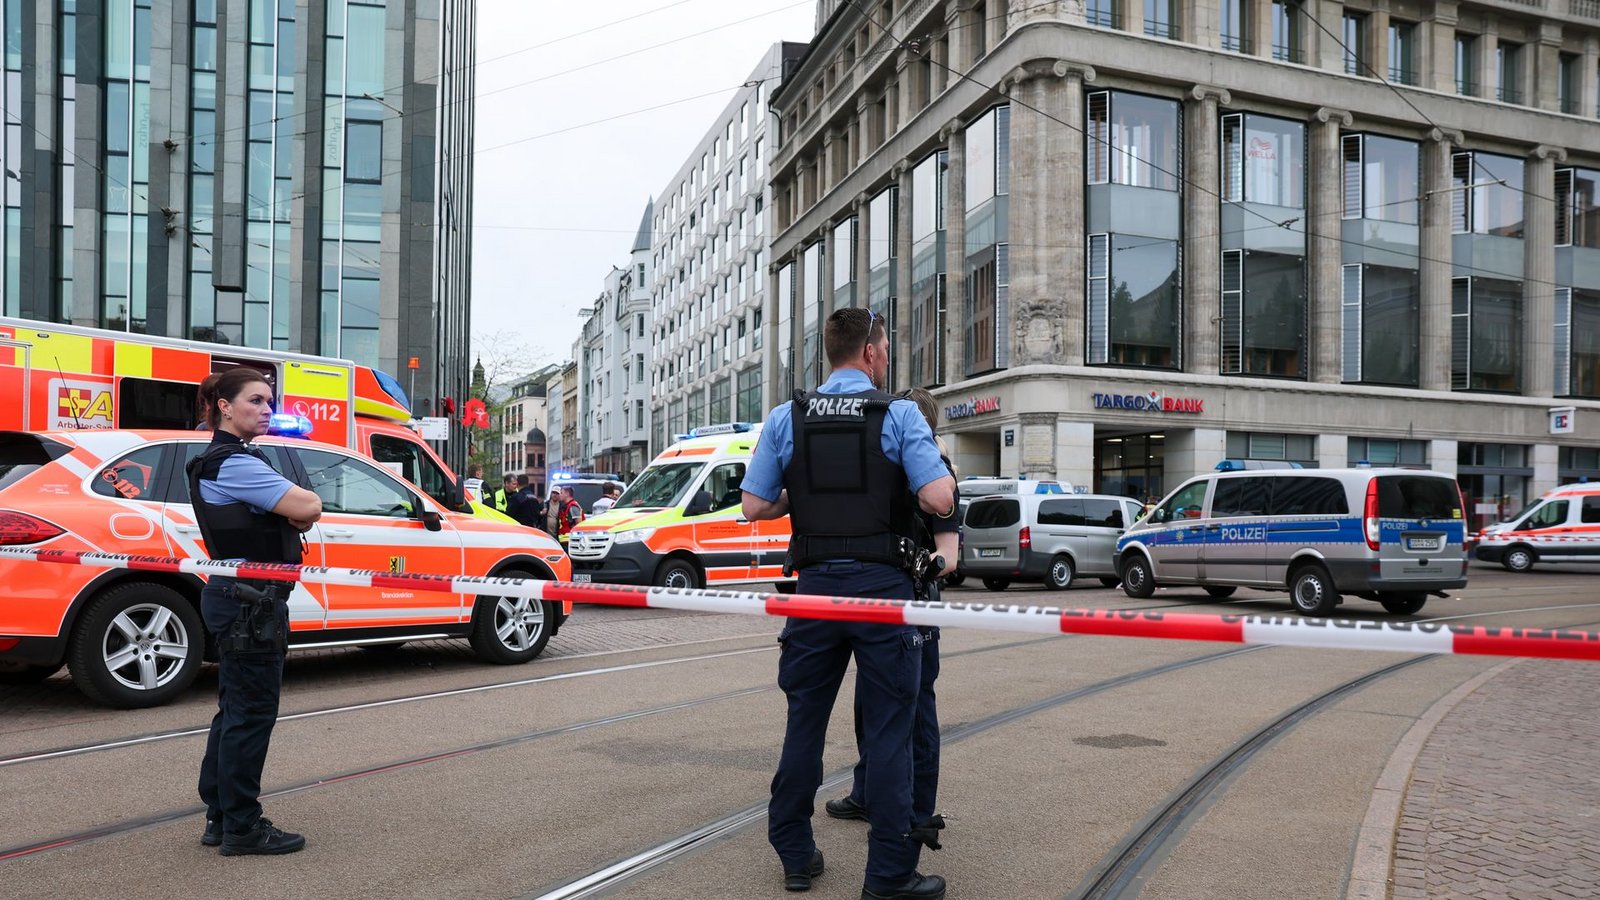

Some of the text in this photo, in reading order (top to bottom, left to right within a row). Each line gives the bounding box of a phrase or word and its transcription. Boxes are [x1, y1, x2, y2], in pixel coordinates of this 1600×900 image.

[1247, 150, 1276, 160] WELLA
[311, 402, 340, 422] 112
[806, 397, 868, 417] POLIZEI
[112, 479, 140, 499] 112
[1221, 527, 1266, 540] POLIZEI
